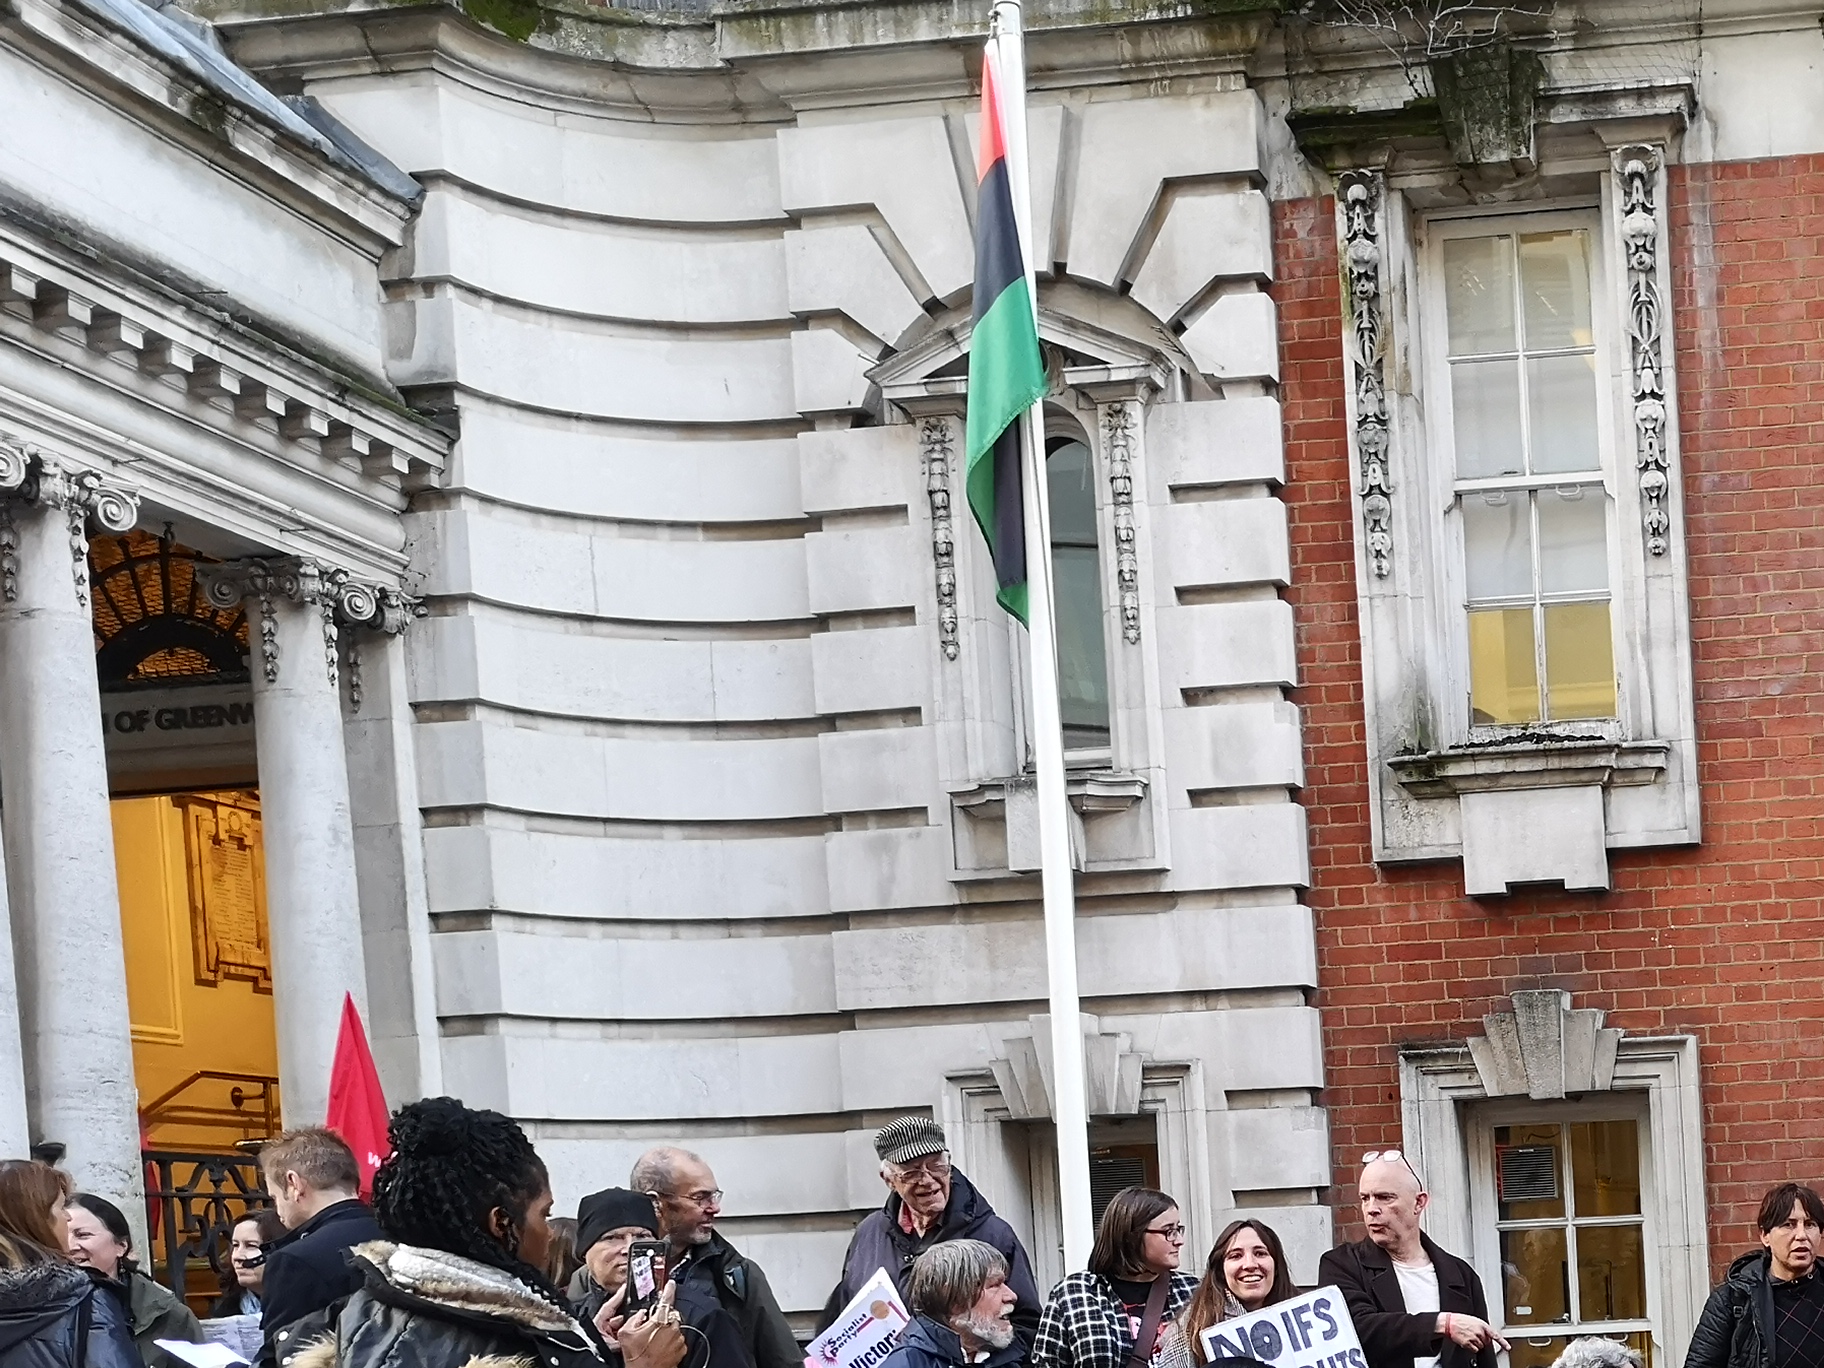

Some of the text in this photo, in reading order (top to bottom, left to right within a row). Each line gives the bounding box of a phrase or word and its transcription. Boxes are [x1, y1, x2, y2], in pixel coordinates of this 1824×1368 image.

[114, 710, 149, 733] OF
[154, 702, 254, 731] GREENW
[827, 1313, 868, 1349] Socialist
[829, 1330, 859, 1358] Party
[1208, 1297, 1339, 1361] NO IFS
